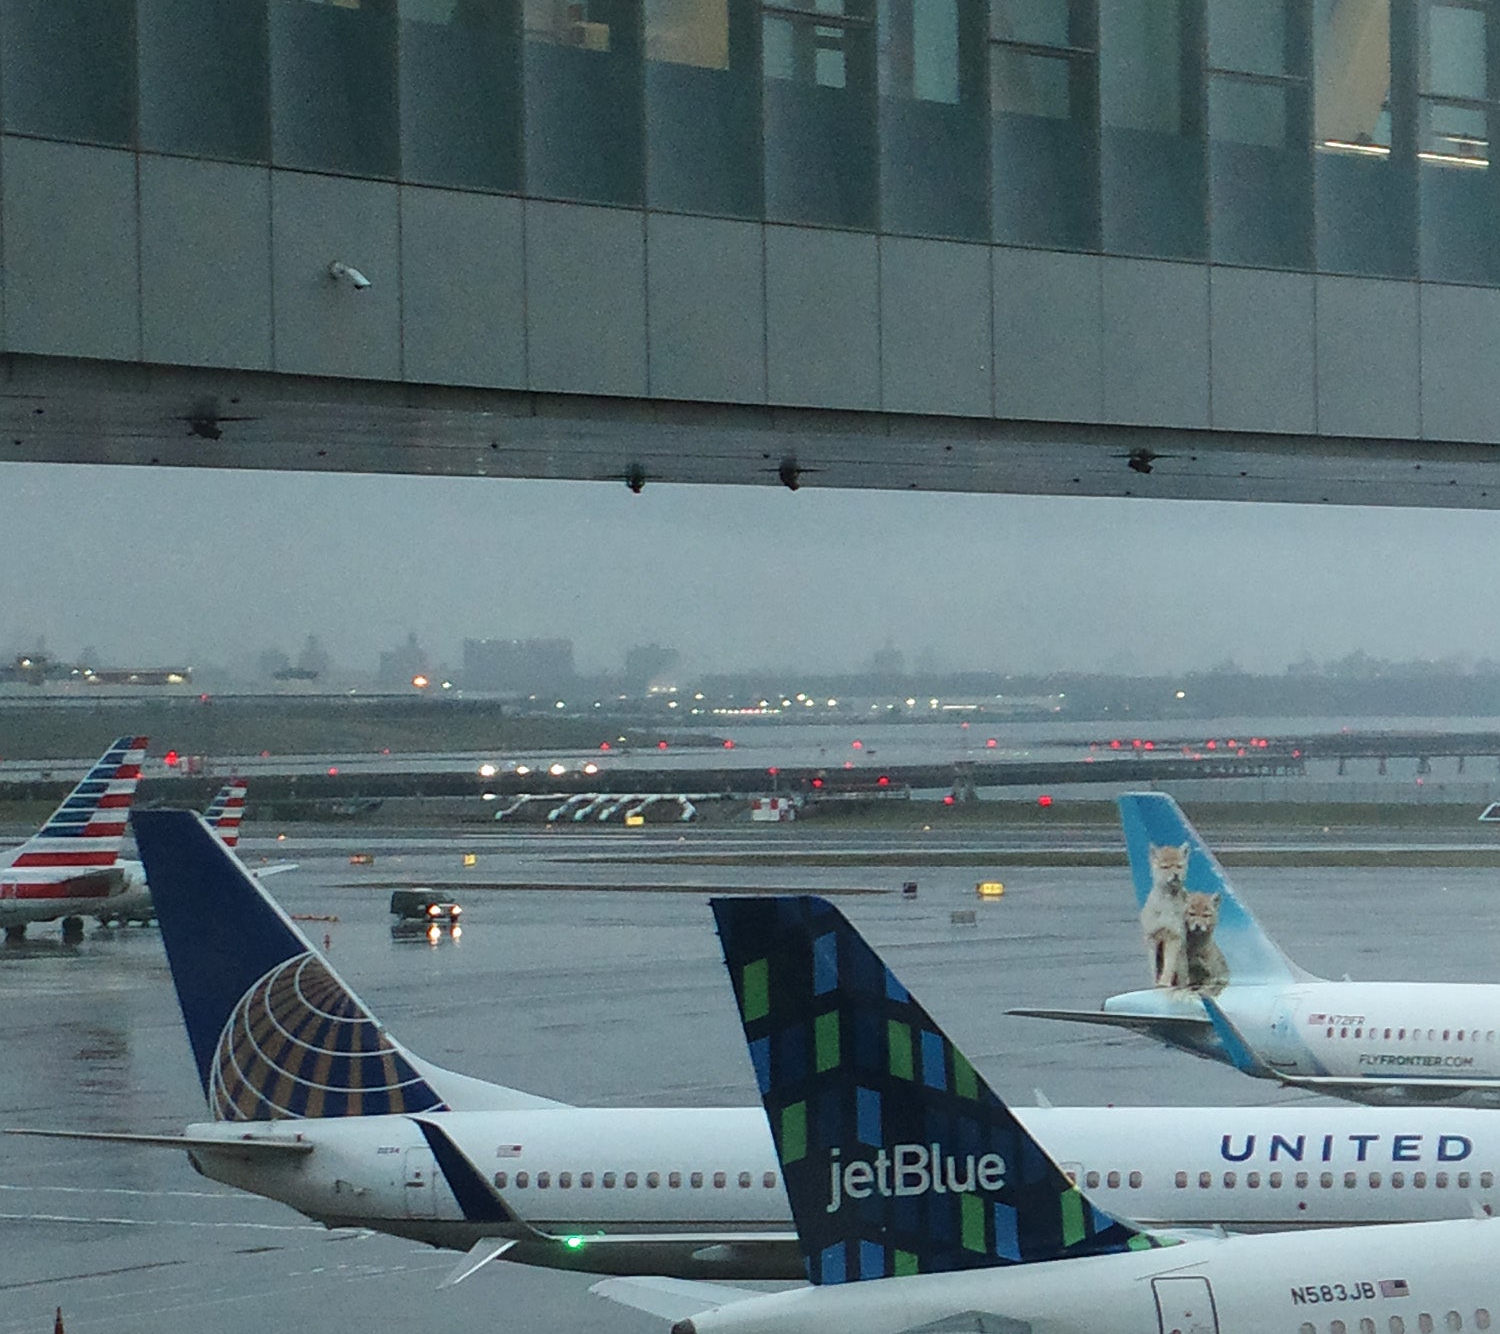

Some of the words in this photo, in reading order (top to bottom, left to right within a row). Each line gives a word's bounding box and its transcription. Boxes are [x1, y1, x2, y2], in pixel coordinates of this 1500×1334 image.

[1359, 1054, 1474, 1067] FLYFRONTIER.COM
[1221, 1134, 1474, 1162] UNITED
[827, 1143, 1006, 1213] jetBlue
[1291, 1281, 1376, 1305] N583JB
